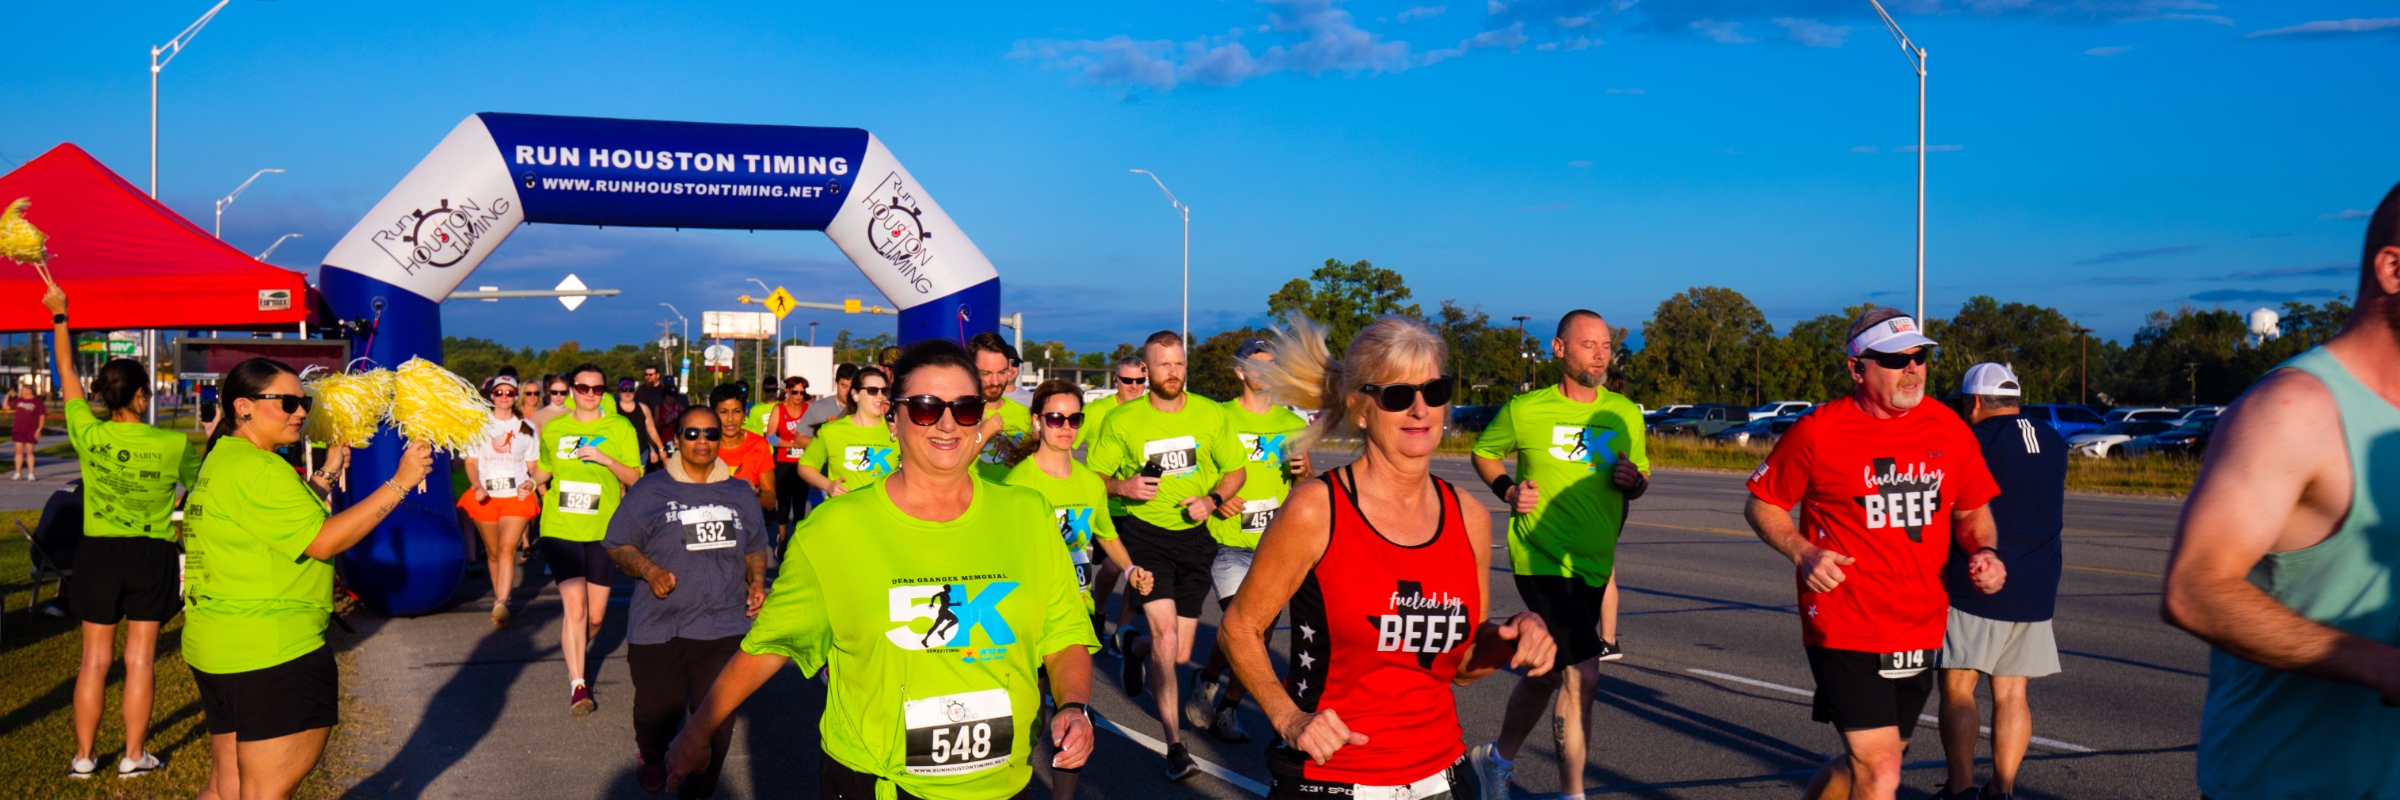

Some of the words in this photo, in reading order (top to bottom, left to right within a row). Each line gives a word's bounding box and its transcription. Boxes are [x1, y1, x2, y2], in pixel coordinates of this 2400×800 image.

[515, 145, 580, 167] RUN
[589, 148, 736, 172] HOUSTON
[742, 154, 848, 176] TIMING
[542, 177, 824, 198] WWW.RUNHOUSTONTIMING.NET
[882, 171, 918, 208] Run
[371, 214, 415, 252] Run
[402, 196, 481, 277] HOUSTON
[449, 197, 510, 256] TIMING
[861, 197, 934, 267] HOUSTON
[879, 237, 933, 294] TIMING
[842, 446, 893, 472] 5K
[1237, 433, 1287, 461] 5K
[1548, 426, 1619, 464] 5K
[1160, 450, 1188, 470] 490
[492, 478, 510, 490] 575
[1864, 463, 1918, 488] fueled
[1919, 462, 1945, 491] by
[566, 492, 591, 509] 529
[1864, 490, 1938, 529] BEEF
[695, 521, 727, 543] 532
[1250, 510, 1274, 528] 451
[961, 573, 1008, 581] MEMORIAL
[885, 581, 1021, 651] 5K
[1389, 591, 1441, 610] fueled
[1443, 591, 1464, 616] by
[1377, 614, 1466, 654] BEEF
[1892, 649, 1924, 669] 514
[931, 722, 992, 765] 548
[913, 758, 1005, 773] WWW.RUNHOUSTONTIMING.NET
